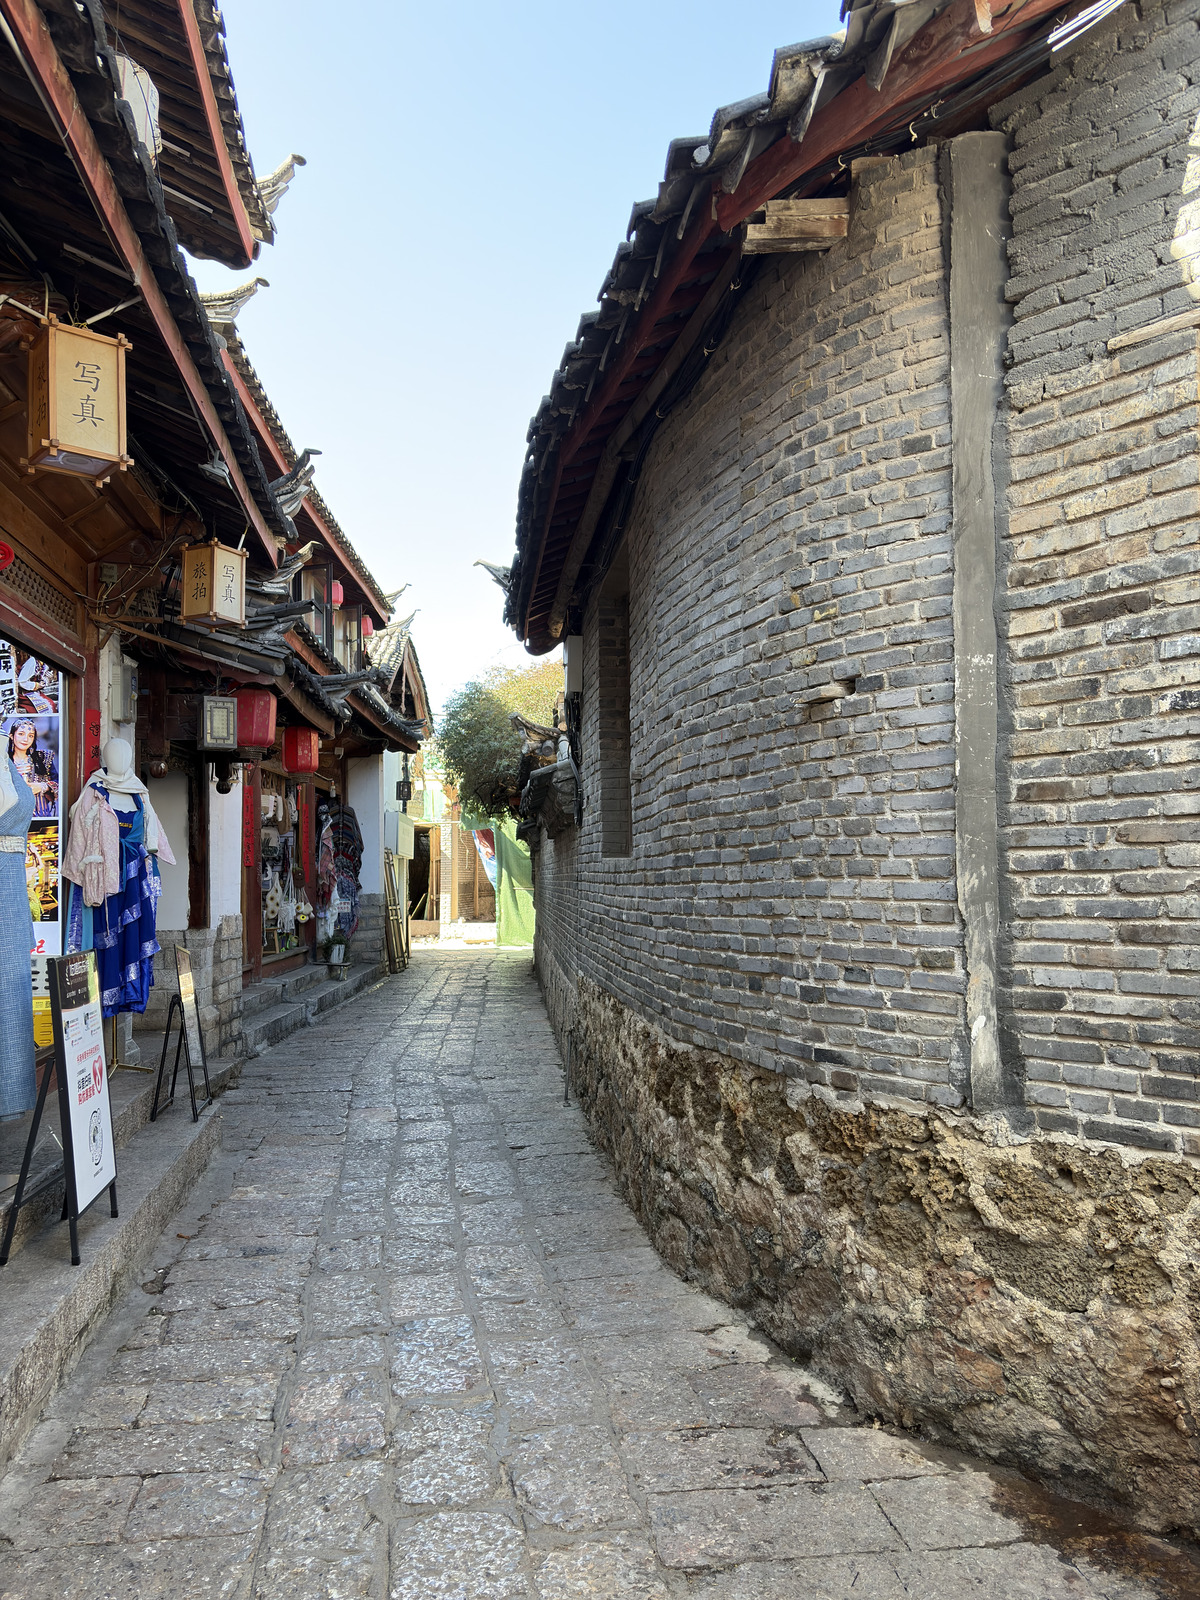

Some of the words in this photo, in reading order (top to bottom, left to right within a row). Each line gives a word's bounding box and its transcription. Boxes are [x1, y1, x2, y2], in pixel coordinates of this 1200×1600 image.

[72, 360, 105, 428] 写真
[192, 561, 207, 600] 旅拍
[221, 564, 236, 603] 写真
